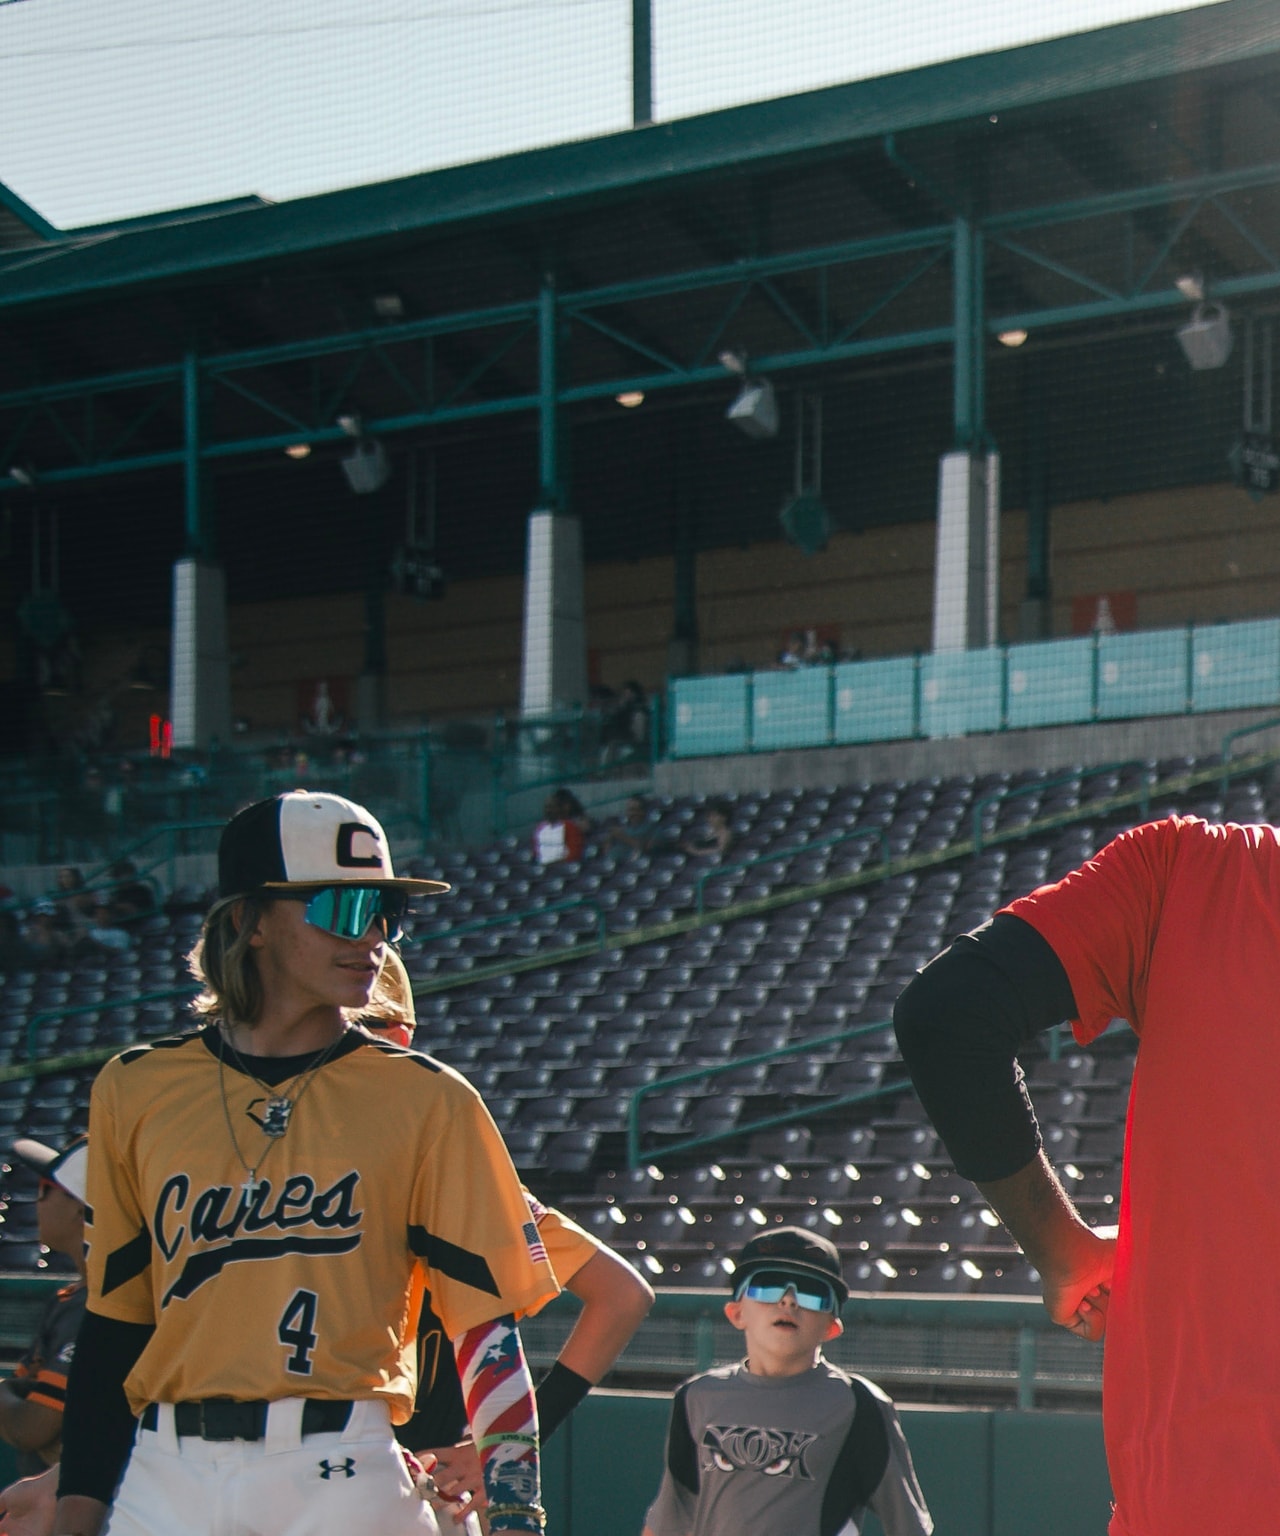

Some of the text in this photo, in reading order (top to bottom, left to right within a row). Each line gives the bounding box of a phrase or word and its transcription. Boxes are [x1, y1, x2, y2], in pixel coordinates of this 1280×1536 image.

[336, 822, 383, 868] C
[154, 1169, 365, 1263] Canes
[277, 1286, 319, 1376] 4
